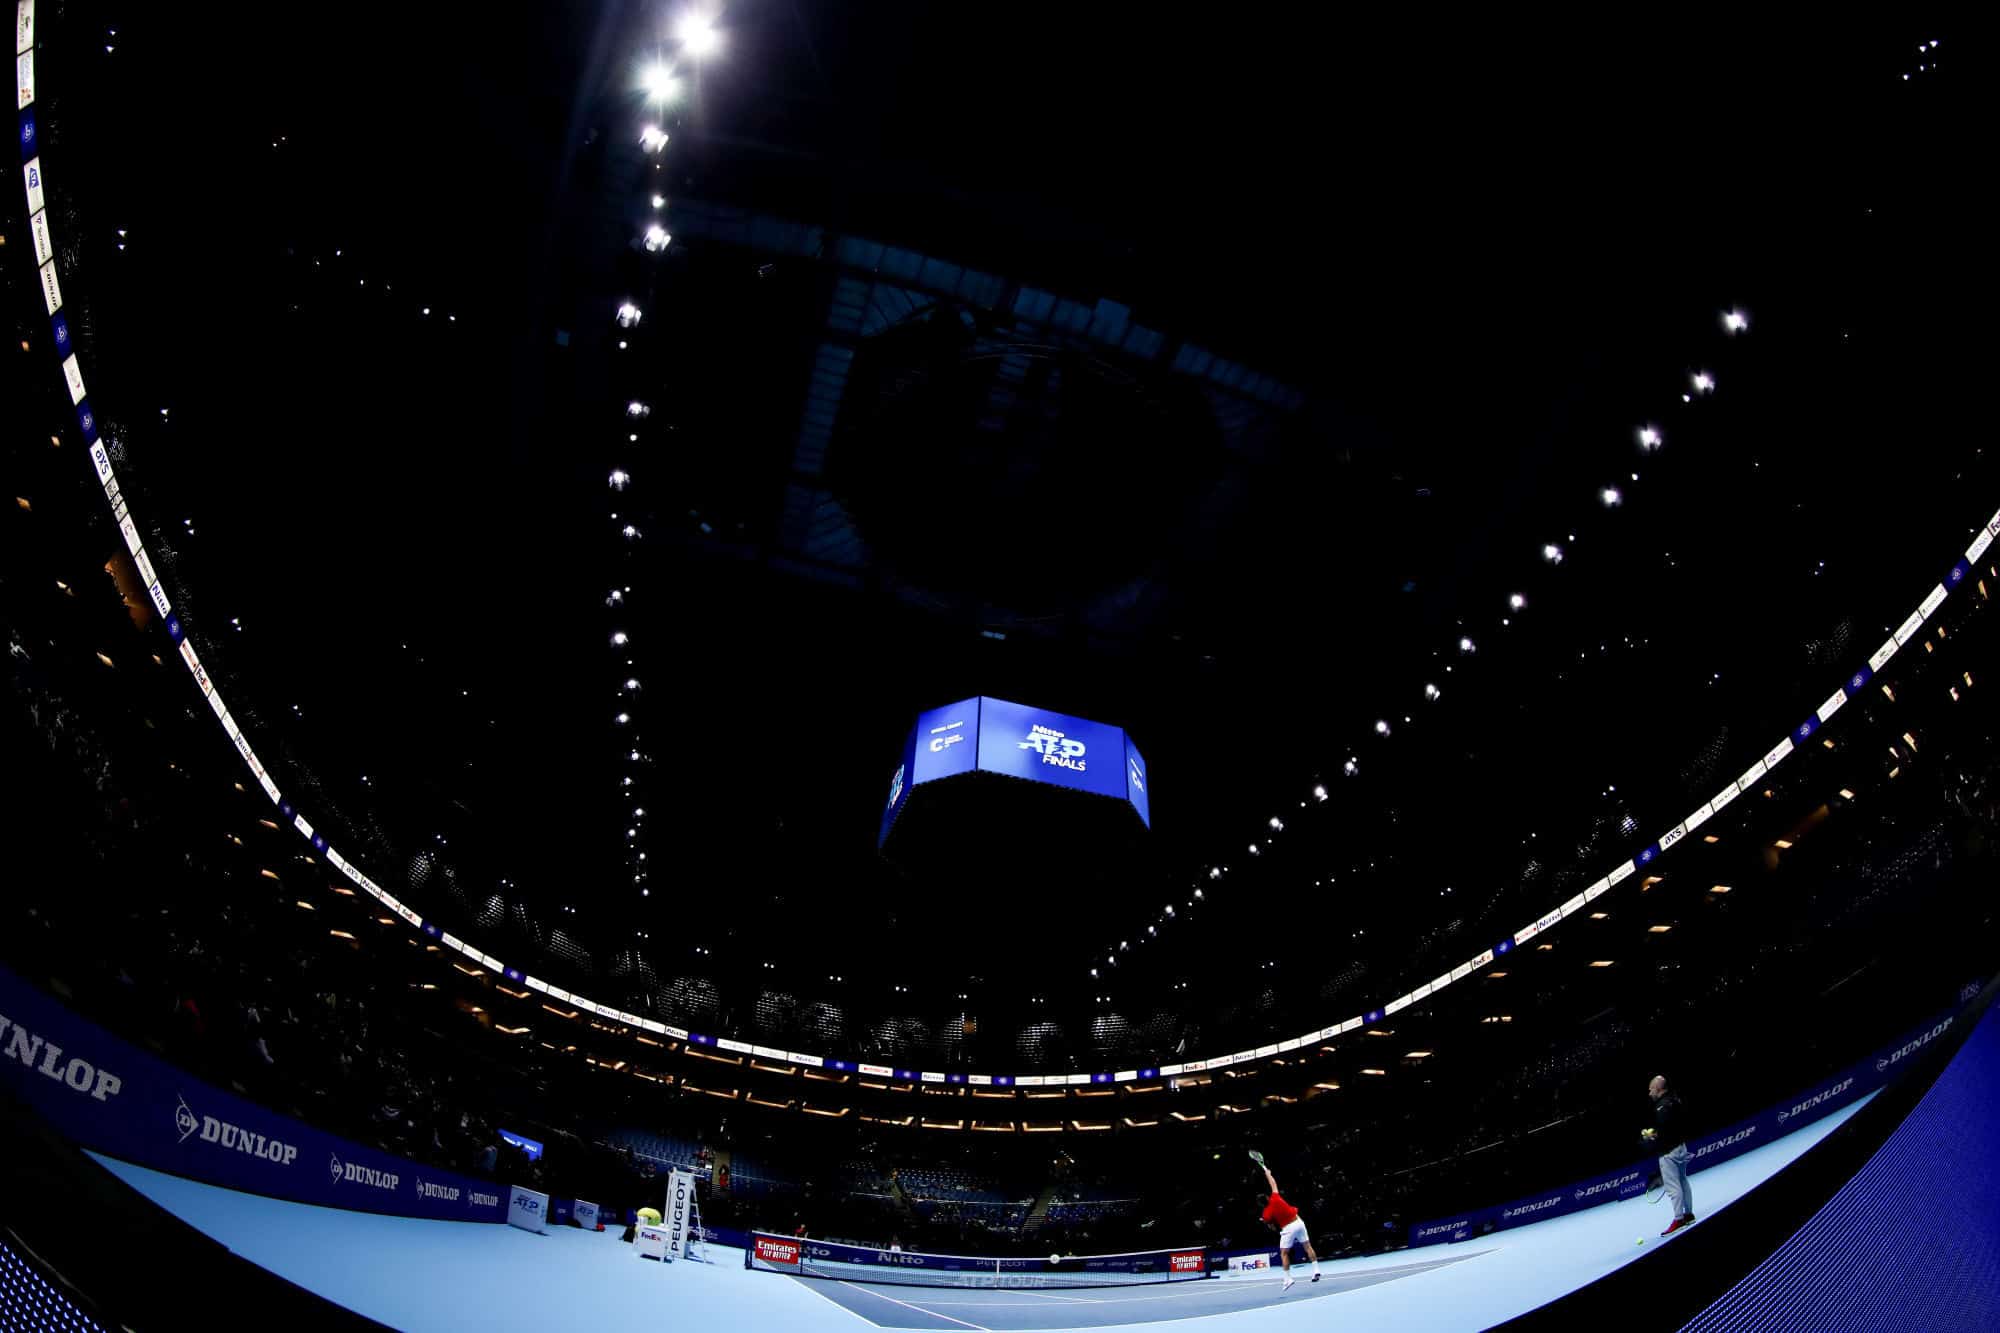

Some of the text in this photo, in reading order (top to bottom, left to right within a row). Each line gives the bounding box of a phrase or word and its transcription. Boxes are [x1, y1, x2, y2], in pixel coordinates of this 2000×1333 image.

[95, 448, 109, 475] axs
[152, 585, 168, 615] Nitto
[1032, 724, 1065, 738] Nitto
[1017, 732, 1086, 758] ATP
[1042, 754, 1086, 772] FINALS
[1664, 828, 1682, 846] axs
[1539, 913, 1561, 929] Nitto
[1889, 1016, 1953, 1065] DUNLOP
[1789, 1078, 1853, 1117] DUNLOP
[200, 1115, 297, 1166] DUNLOP
[1696, 1126, 1756, 1159] DUNLOP
[344, 1163, 399, 1190] DUNLOP
[1585, 1171, 1640, 1196] DUNLOP
[425, 1182, 460, 1202] DUNLOP
[473, 1191, 498, 1207] DUNLOP
[671, 1178, 686, 1252] PEUGEOT
[1512, 1196, 1561, 1216] DUNLOP
[1425, 1220, 1468, 1236] DUNLOP
[757, 1240, 797, 1255] Emirates
[877, 1252, 925, 1265] Nitto
[1172, 1255, 1202, 1264] Emirates
[1242, 1260, 1268, 1271] FedEx
